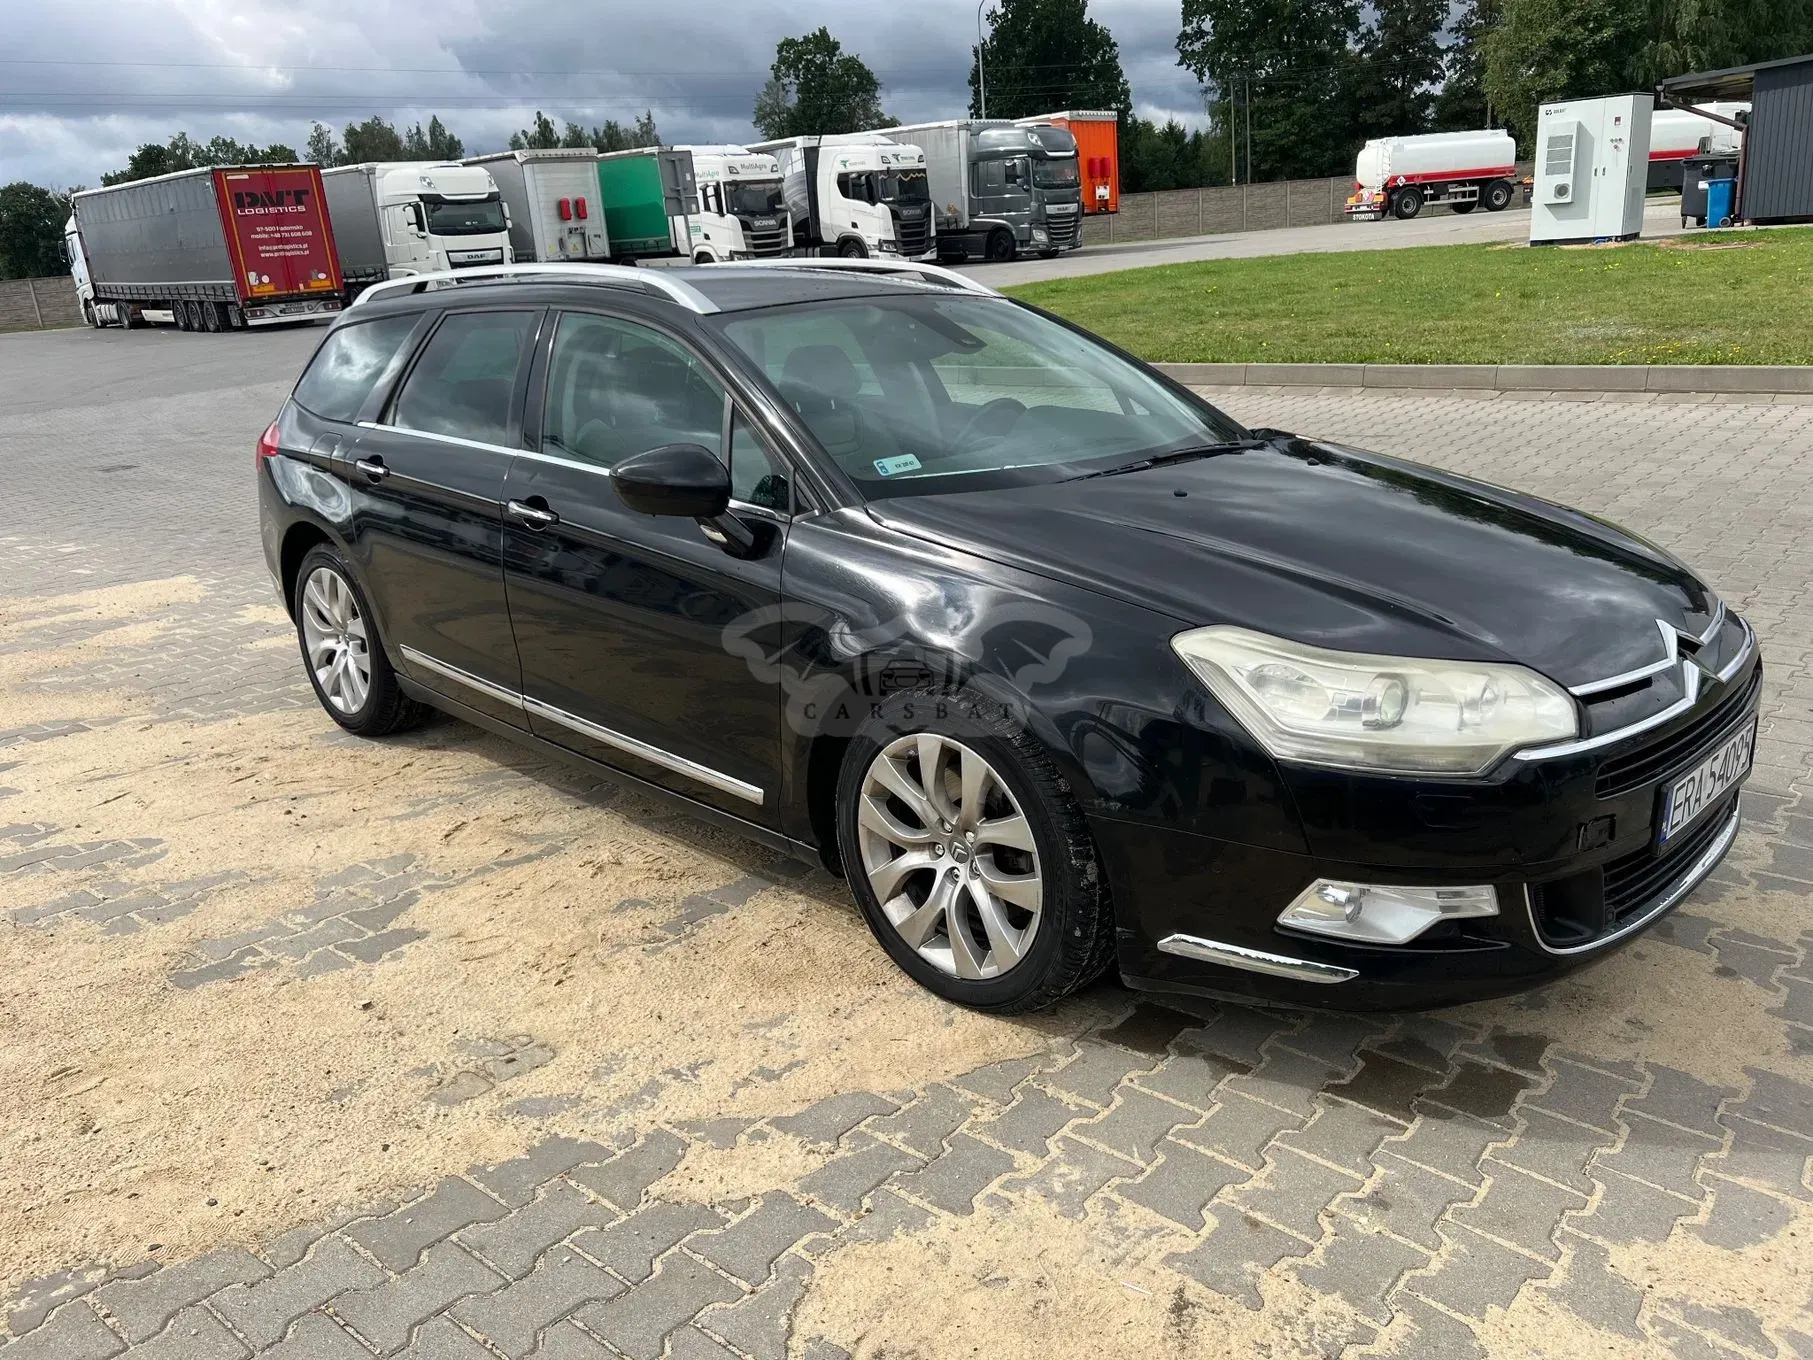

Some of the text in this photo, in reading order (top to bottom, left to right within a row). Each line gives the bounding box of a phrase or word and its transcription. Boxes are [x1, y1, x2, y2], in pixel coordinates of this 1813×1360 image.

[237, 205, 306, 215] LOGISTICS
[754, 219, 777, 227] SCANIA
[1670, 727, 1753, 831] ERA 54095
